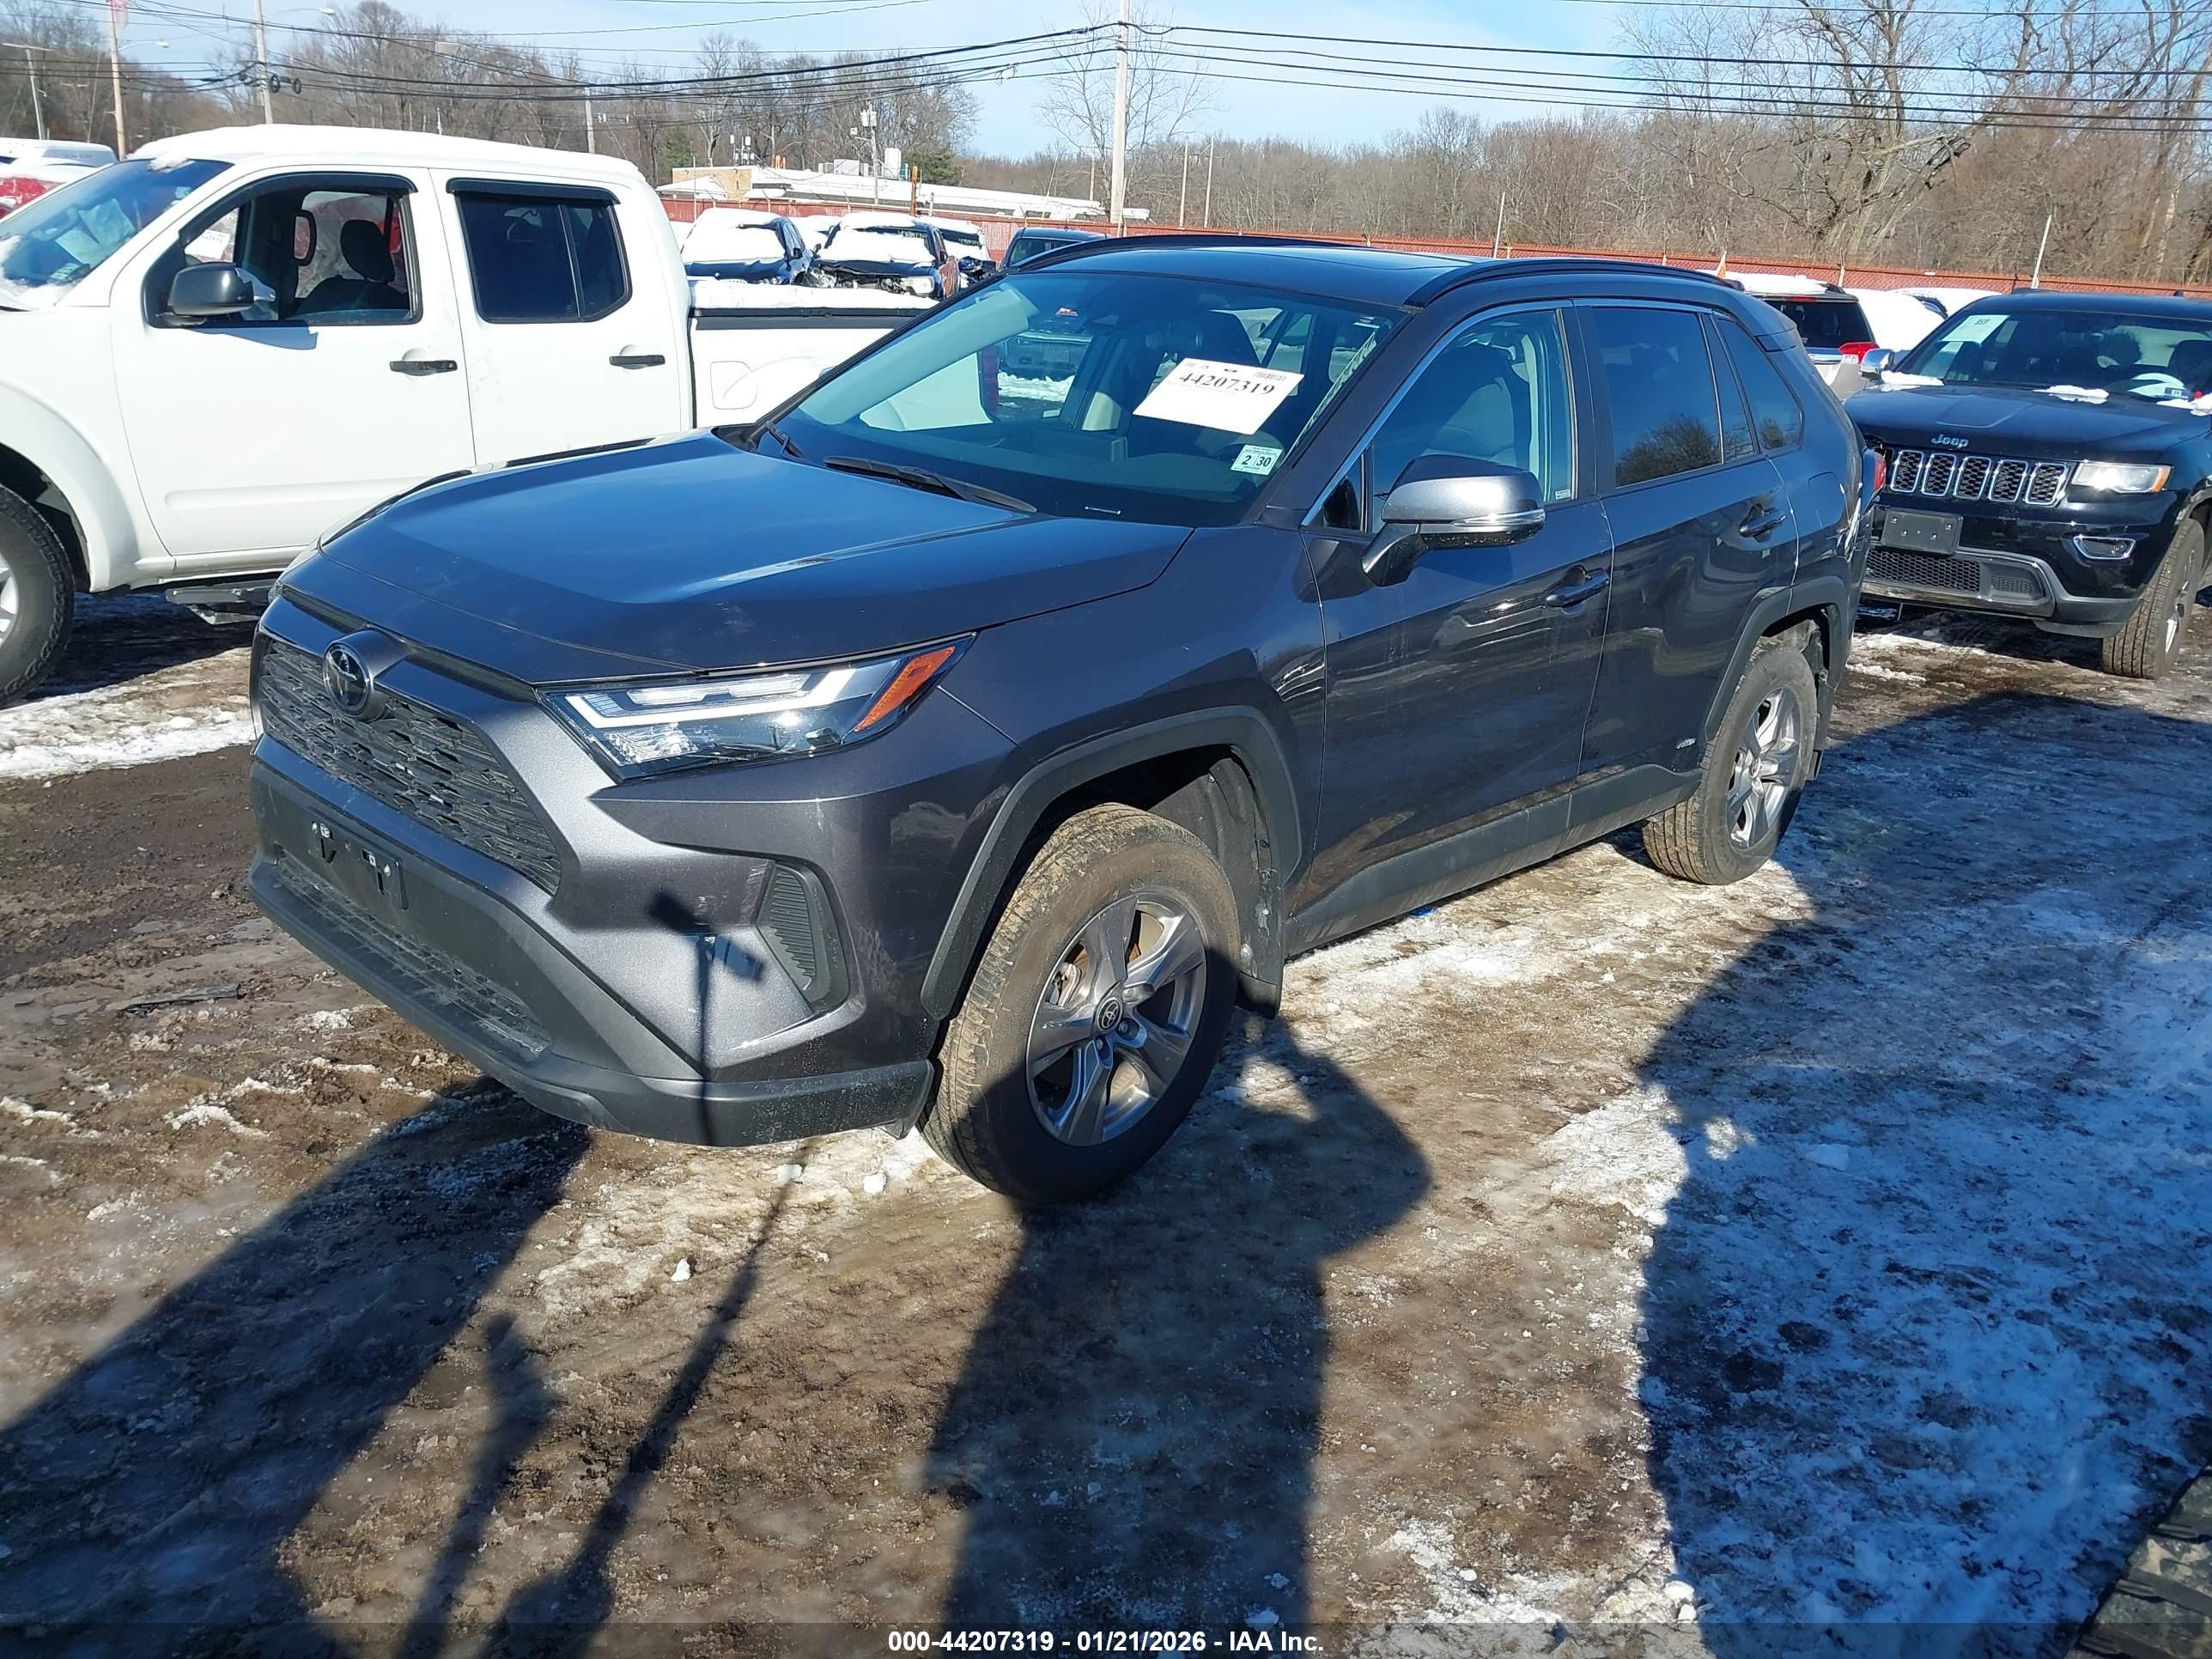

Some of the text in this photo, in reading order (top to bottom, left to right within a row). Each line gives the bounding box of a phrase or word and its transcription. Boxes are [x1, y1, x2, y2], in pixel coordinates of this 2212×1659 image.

[1179, 373, 1275, 395] 44207319
[1930, 433, 1969, 449] Jeep
[1241, 454, 1272, 467] 2 30
